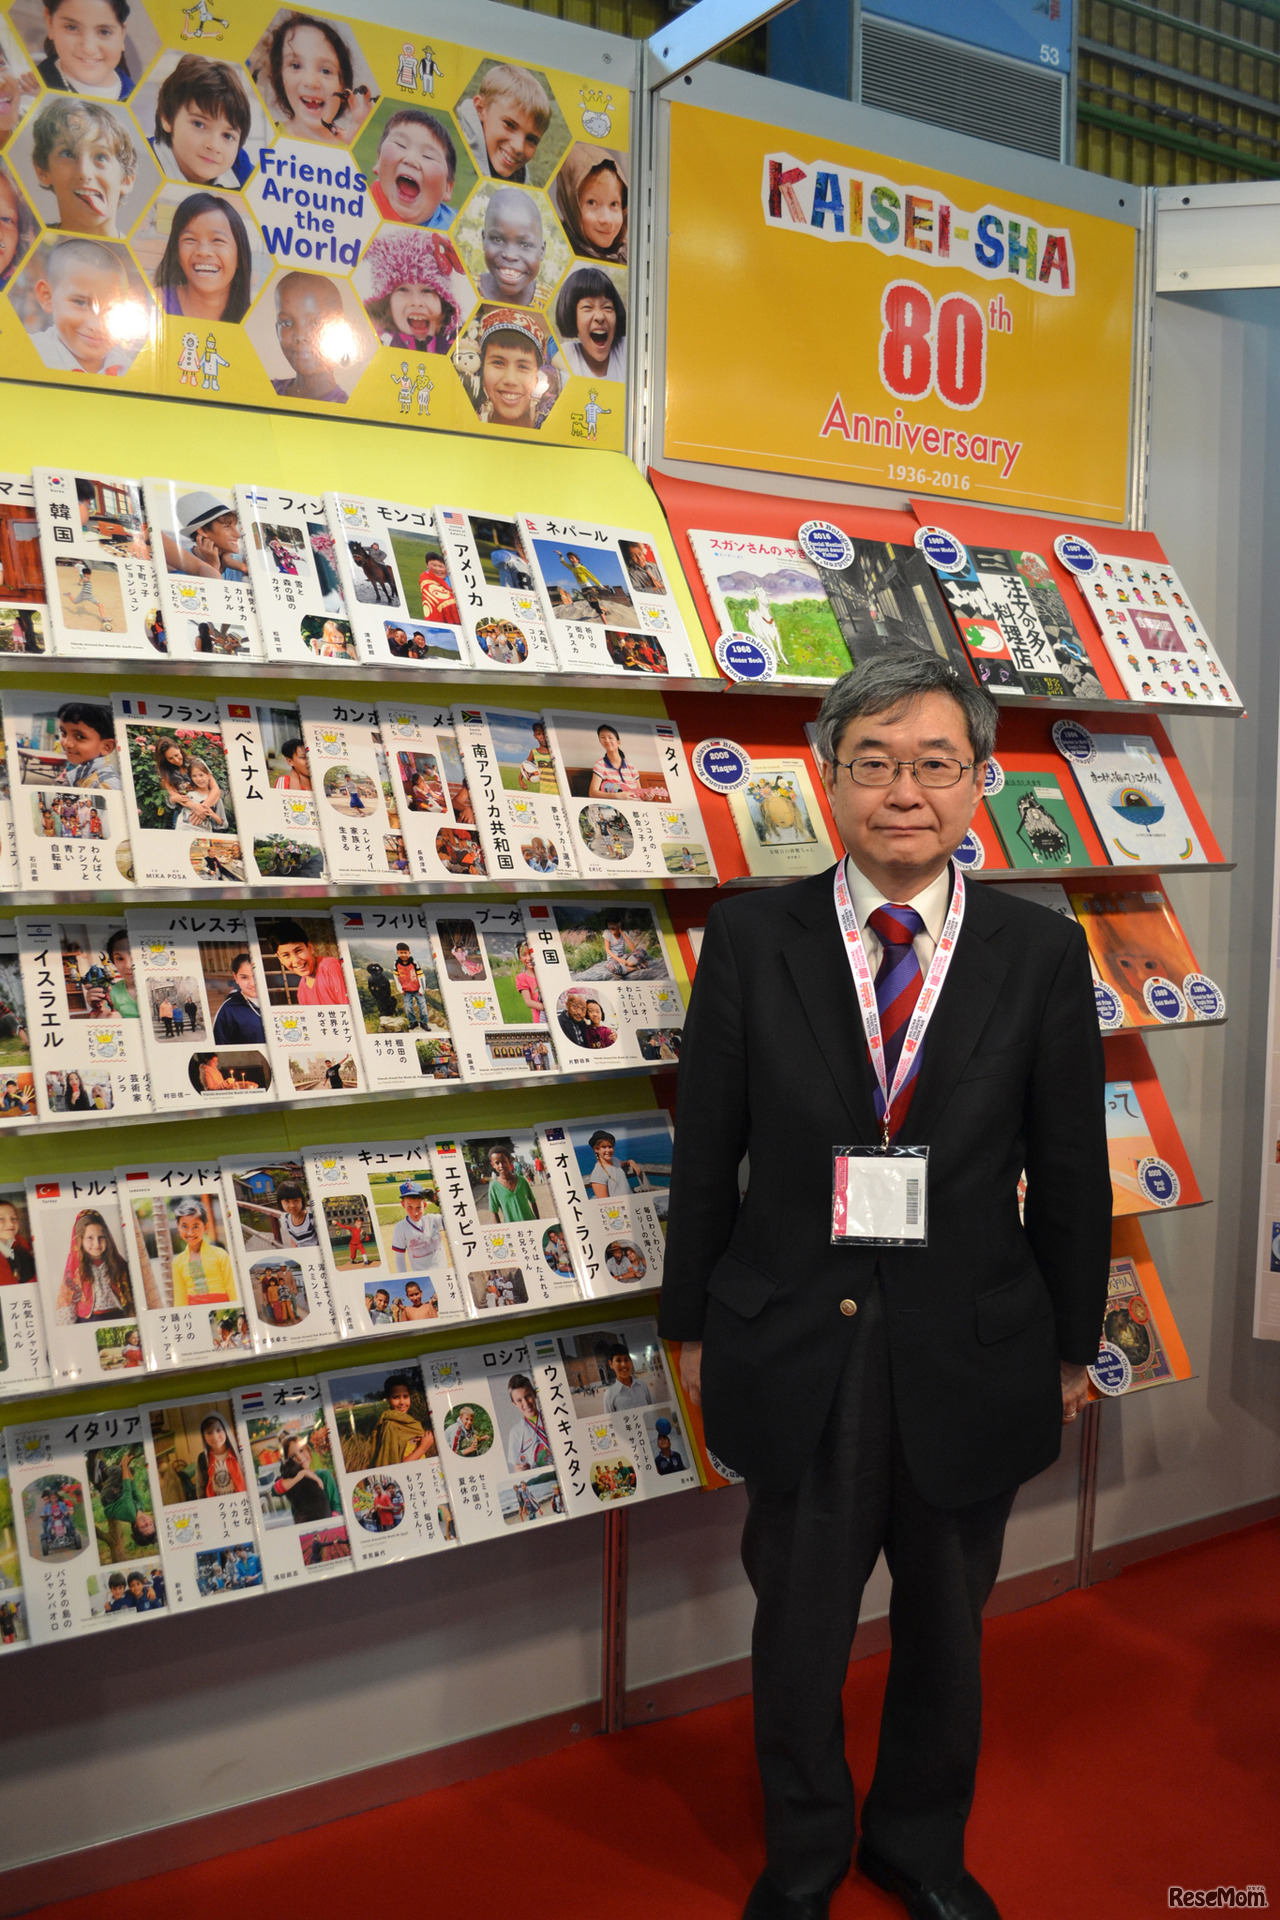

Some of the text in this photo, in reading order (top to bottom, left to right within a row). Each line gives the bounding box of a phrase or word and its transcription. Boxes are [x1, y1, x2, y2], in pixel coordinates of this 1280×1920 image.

[1040, 44, 1060, 66] 53
[259, 148, 368, 193] Friends
[262, 180, 365, 218] Around
[295, 210, 335, 234] the
[768, 159, 1071, 290] KAISEI-SHA
[261, 225, 362, 267] World
[820, 395, 1022, 478] Anniversary
[887, 463, 971, 490] 1936-2016
[279, 497, 324, 514] フィン
[49, 503, 74, 543] 韓国
[546, 521, 608, 542] ネパール
[710, 539, 782, 556] スガンさんの
[137, 564, 149, 597] 下町っ子
[272, 578, 281, 601] カオリ
[295, 580, 303, 595] 雪と
[454, 543, 483, 607] アメリカ
[224, 586, 234, 610] ミゲル
[235, 588, 247, 621] カリオカ
[283, 579, 296, 610] 森の国の
[575, 626, 585, 640] 街の
[1001, 576, 1051, 664] 注文の多い
[529, 629, 539, 650] コリン
[538, 629, 549, 651] 太陽と
[565, 625, 579, 654] アヌスカ
[585, 627, 597, 649] 祈りの
[992, 602, 1035, 670] 料理店
[235, 731, 263, 800] ベトナム
[665, 746, 679, 777] タイ
[695, 744, 711, 778] Bratislava
[709, 751, 730, 760] 2005
[723, 741, 749, 765] Biennial
[710, 765, 737, 773] Plaque
[472, 743, 514, 869] 南アフリカ共和国
[339, 827, 350, 851] 生きる
[350, 827, 361, 852] 家族と
[551, 806, 572, 868] 夢はサッカー選手
[632, 811, 645, 841] 都会っ子
[642, 812, 657, 850] バンコクの
[51, 844, 62, 871] 自転車
[64, 844, 74, 861] 青い
[78, 845, 89, 880] アシフと
[91, 845, 102, 881] わんぱく
[362, 828, 375, 870] スレイダー
[169, 916, 244, 933] パレスチ
[475, 909, 520, 926] ブータ
[538, 929, 560, 964] 中国
[34, 950, 64, 1048] イスラエル
[617, 986, 631, 1023] チューチン
[625, 986, 639, 1015] わたしは
[317, 1012, 327, 1036] めざす
[328, 1011, 339, 1035] 世界を
[339, 1011, 352, 1044] アルナブ
[87, 1030, 97, 1058] ともだち
[374, 1040, 382, 1056] ネリ
[384, 1040, 394, 1055] 村の
[117, 1075, 127, 1093] シラ
[129, 1074, 143, 1102] 芸術家
[358, 1147, 422, 1166] キューバ
[445, 1167, 477, 1258] エチオピア
[555, 1153, 600, 1280] オーストラリア
[517, 1231, 533, 1271] お兄ちゃん
[526, 1230, 549, 1299] ナティは たよれる
[446, 1274, 456, 1299] エリオ
[10, 1302, 23, 1349] ブルーベル
[171, 1313, 183, 1343] 踊り子
[183, 1313, 195, 1340] バリの
[483, 1346, 528, 1368] ロシア
[1097, 1355, 1112, 1363] 2014
[65, 1416, 140, 1443] イタリア
[544, 1365, 586, 1497] ウズベキスタン
[623, 1415, 633, 1432] 少年
[632, 1414, 652, 1471] シルクロードの
[415, 1472, 436, 1540] アフマド 毎日が
[458, 1478, 470, 1505] 夏休み
[468, 1476, 481, 1510] 北の国の
[479, 1474, 493, 1517] セミョーン
[218, 1502, 231, 1539] クラース
[229, 1501, 240, 1528] ハカセ
[240, 1498, 253, 1526] 小さな
